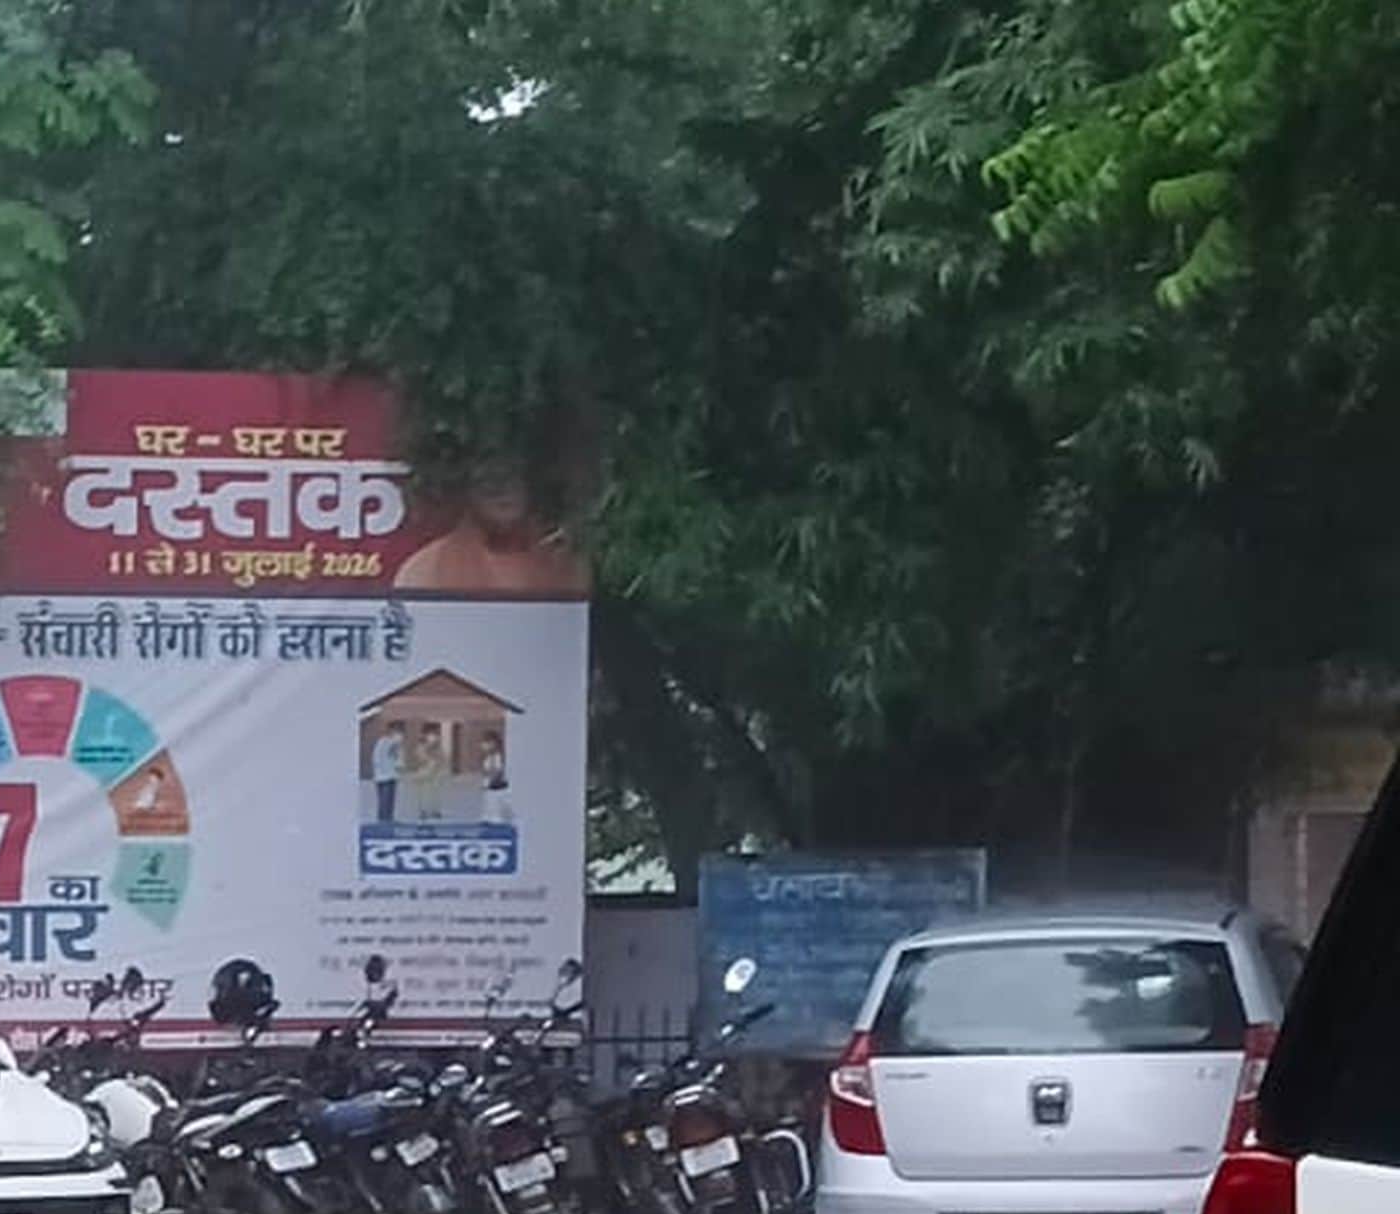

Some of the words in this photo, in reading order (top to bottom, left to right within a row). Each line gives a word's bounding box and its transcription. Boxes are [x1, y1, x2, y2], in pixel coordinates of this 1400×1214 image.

[135, 426, 190, 455] घर
[232, 427, 287, 456] घर
[294, 428, 347, 456] पर
[59, 455, 411, 540] दस्तक
[108, 550, 134, 575] 11
[144, 541, 174, 577] से
[184, 551, 212, 576] 31
[222, 541, 318, 586] जुलाई
[321, 552, 382, 577] 2026
[17, 601, 120, 660] संचारी
[218, 604, 263, 660] को
[274, 613, 377, 661] हराना
[380, 600, 414, 661] है
[363, 838, 512, 870] दस्तक
[47, 875, 101, 902] का
